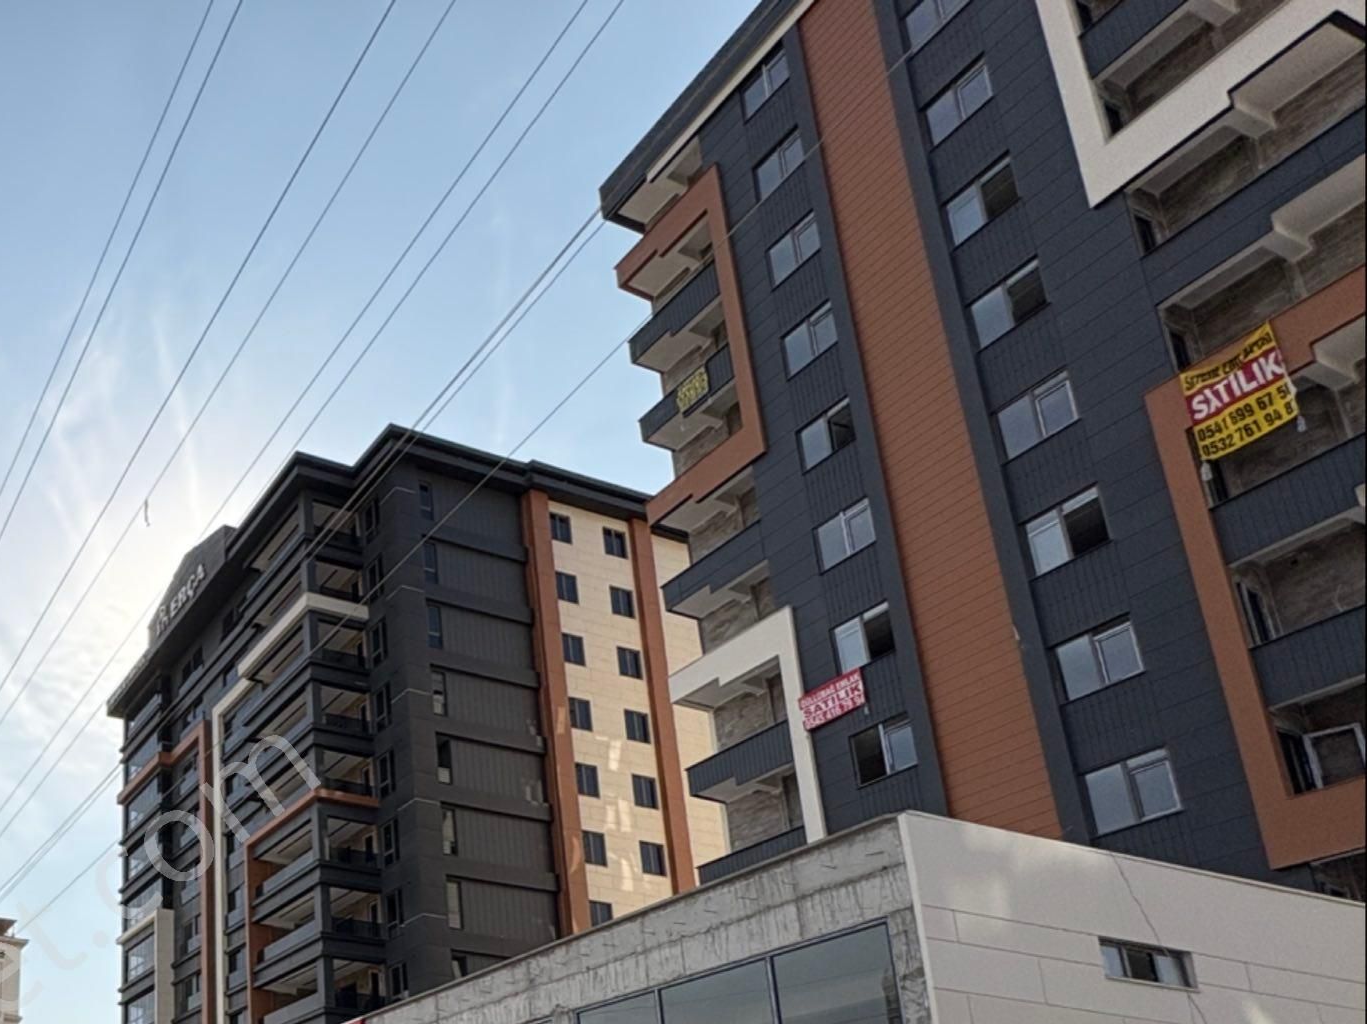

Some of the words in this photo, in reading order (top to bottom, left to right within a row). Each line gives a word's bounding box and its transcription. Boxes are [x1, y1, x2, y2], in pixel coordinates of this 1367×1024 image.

[1256, 391, 1274, 411] 67
[1201, 434, 1234, 457] 0532
[1235, 420, 1262, 442] 761
[1263, 410, 1282, 426] 94
[803, 684, 861, 718] SATILIK
